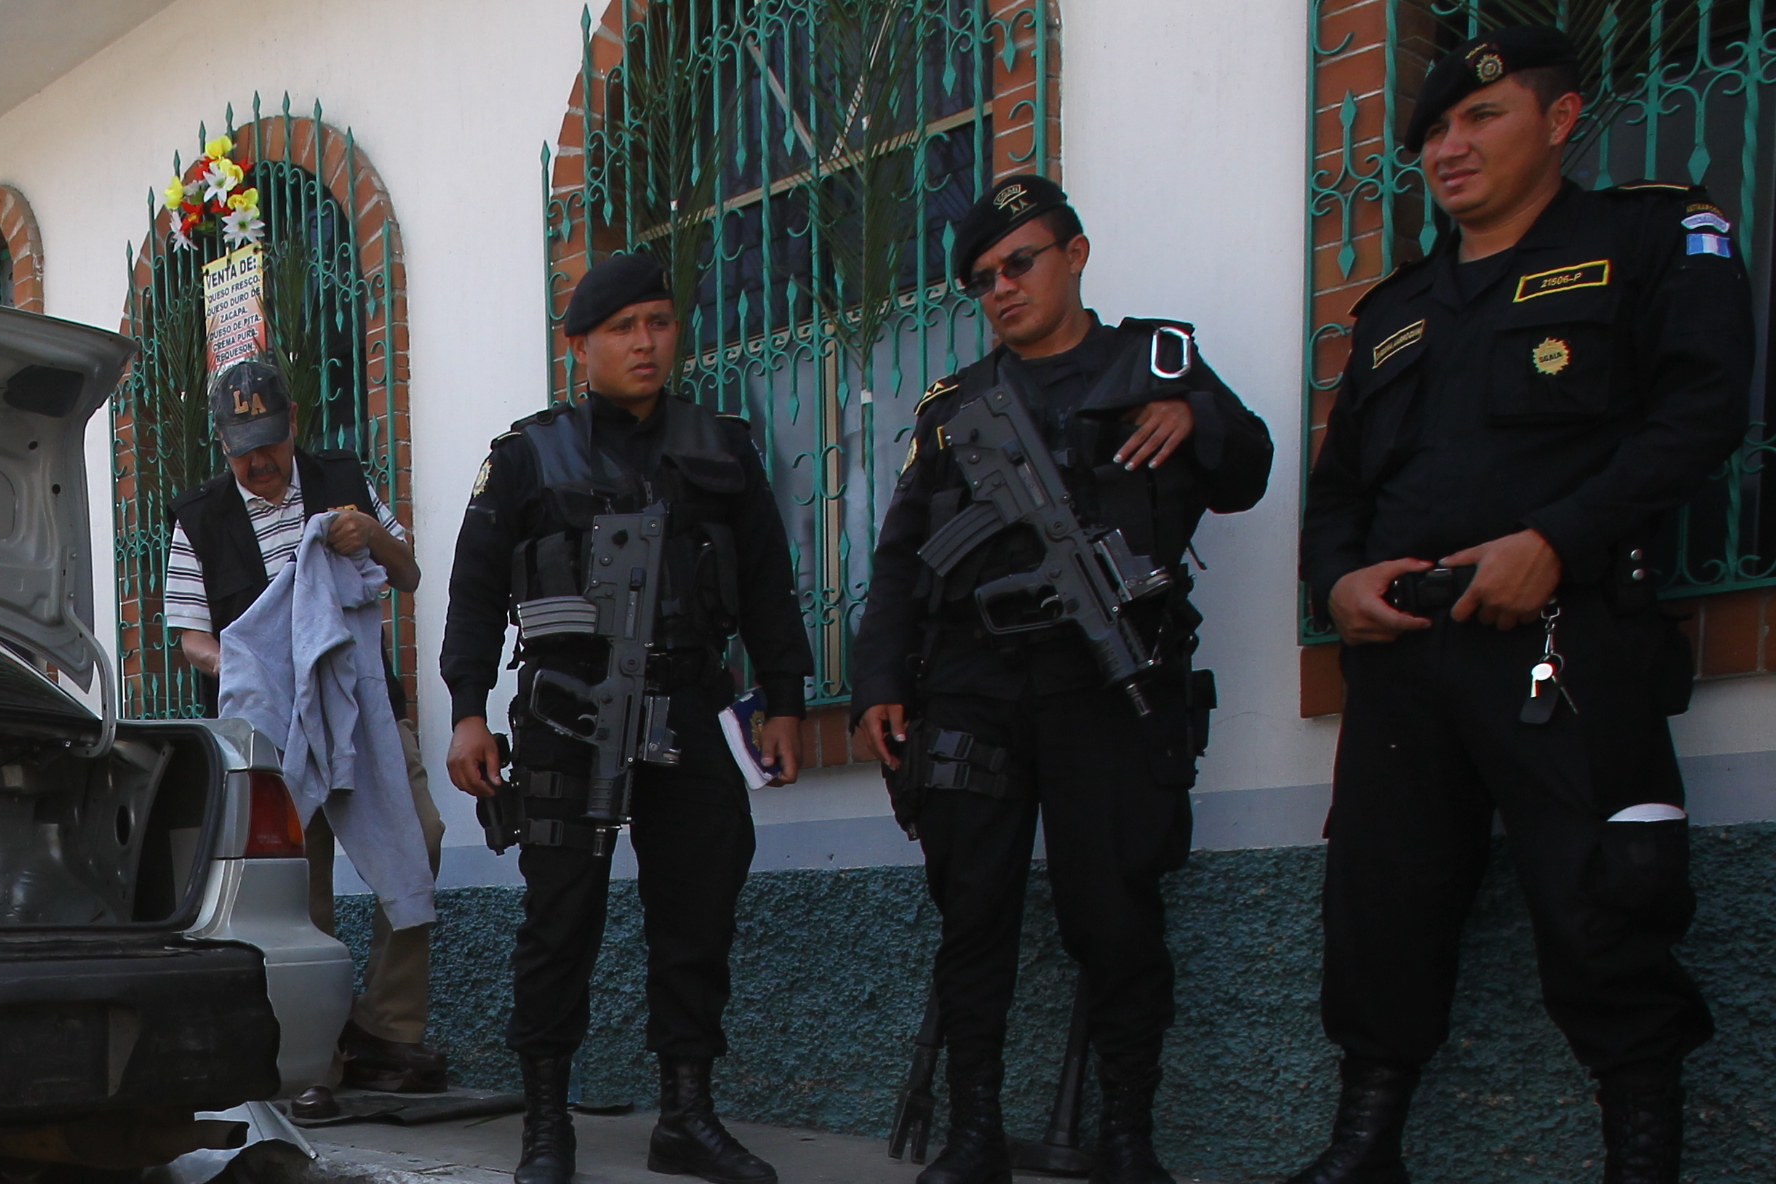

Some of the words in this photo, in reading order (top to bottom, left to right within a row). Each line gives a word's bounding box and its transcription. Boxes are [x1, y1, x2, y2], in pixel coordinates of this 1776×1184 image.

[206, 264, 237, 290] VENTA
[240, 255, 257, 275] DE:
[207, 300, 229, 316] QUESO
[230, 292, 249, 306] DURO
[251, 286, 261, 298] DE
[208, 287, 230, 303] QUESO
[231, 275, 261, 293] FRESCO.
[210, 325, 232, 341] QUESO
[233, 321, 242, 331] DE
[244, 314, 262, 326] PITA.
[220, 306, 248, 323] ZACAPA.
[213, 337, 236, 352] CREMA
[238, 328, 258, 342] PURA.
[216, 342, 256, 363] REQUESON.
[233, 390, 267, 415] LA
